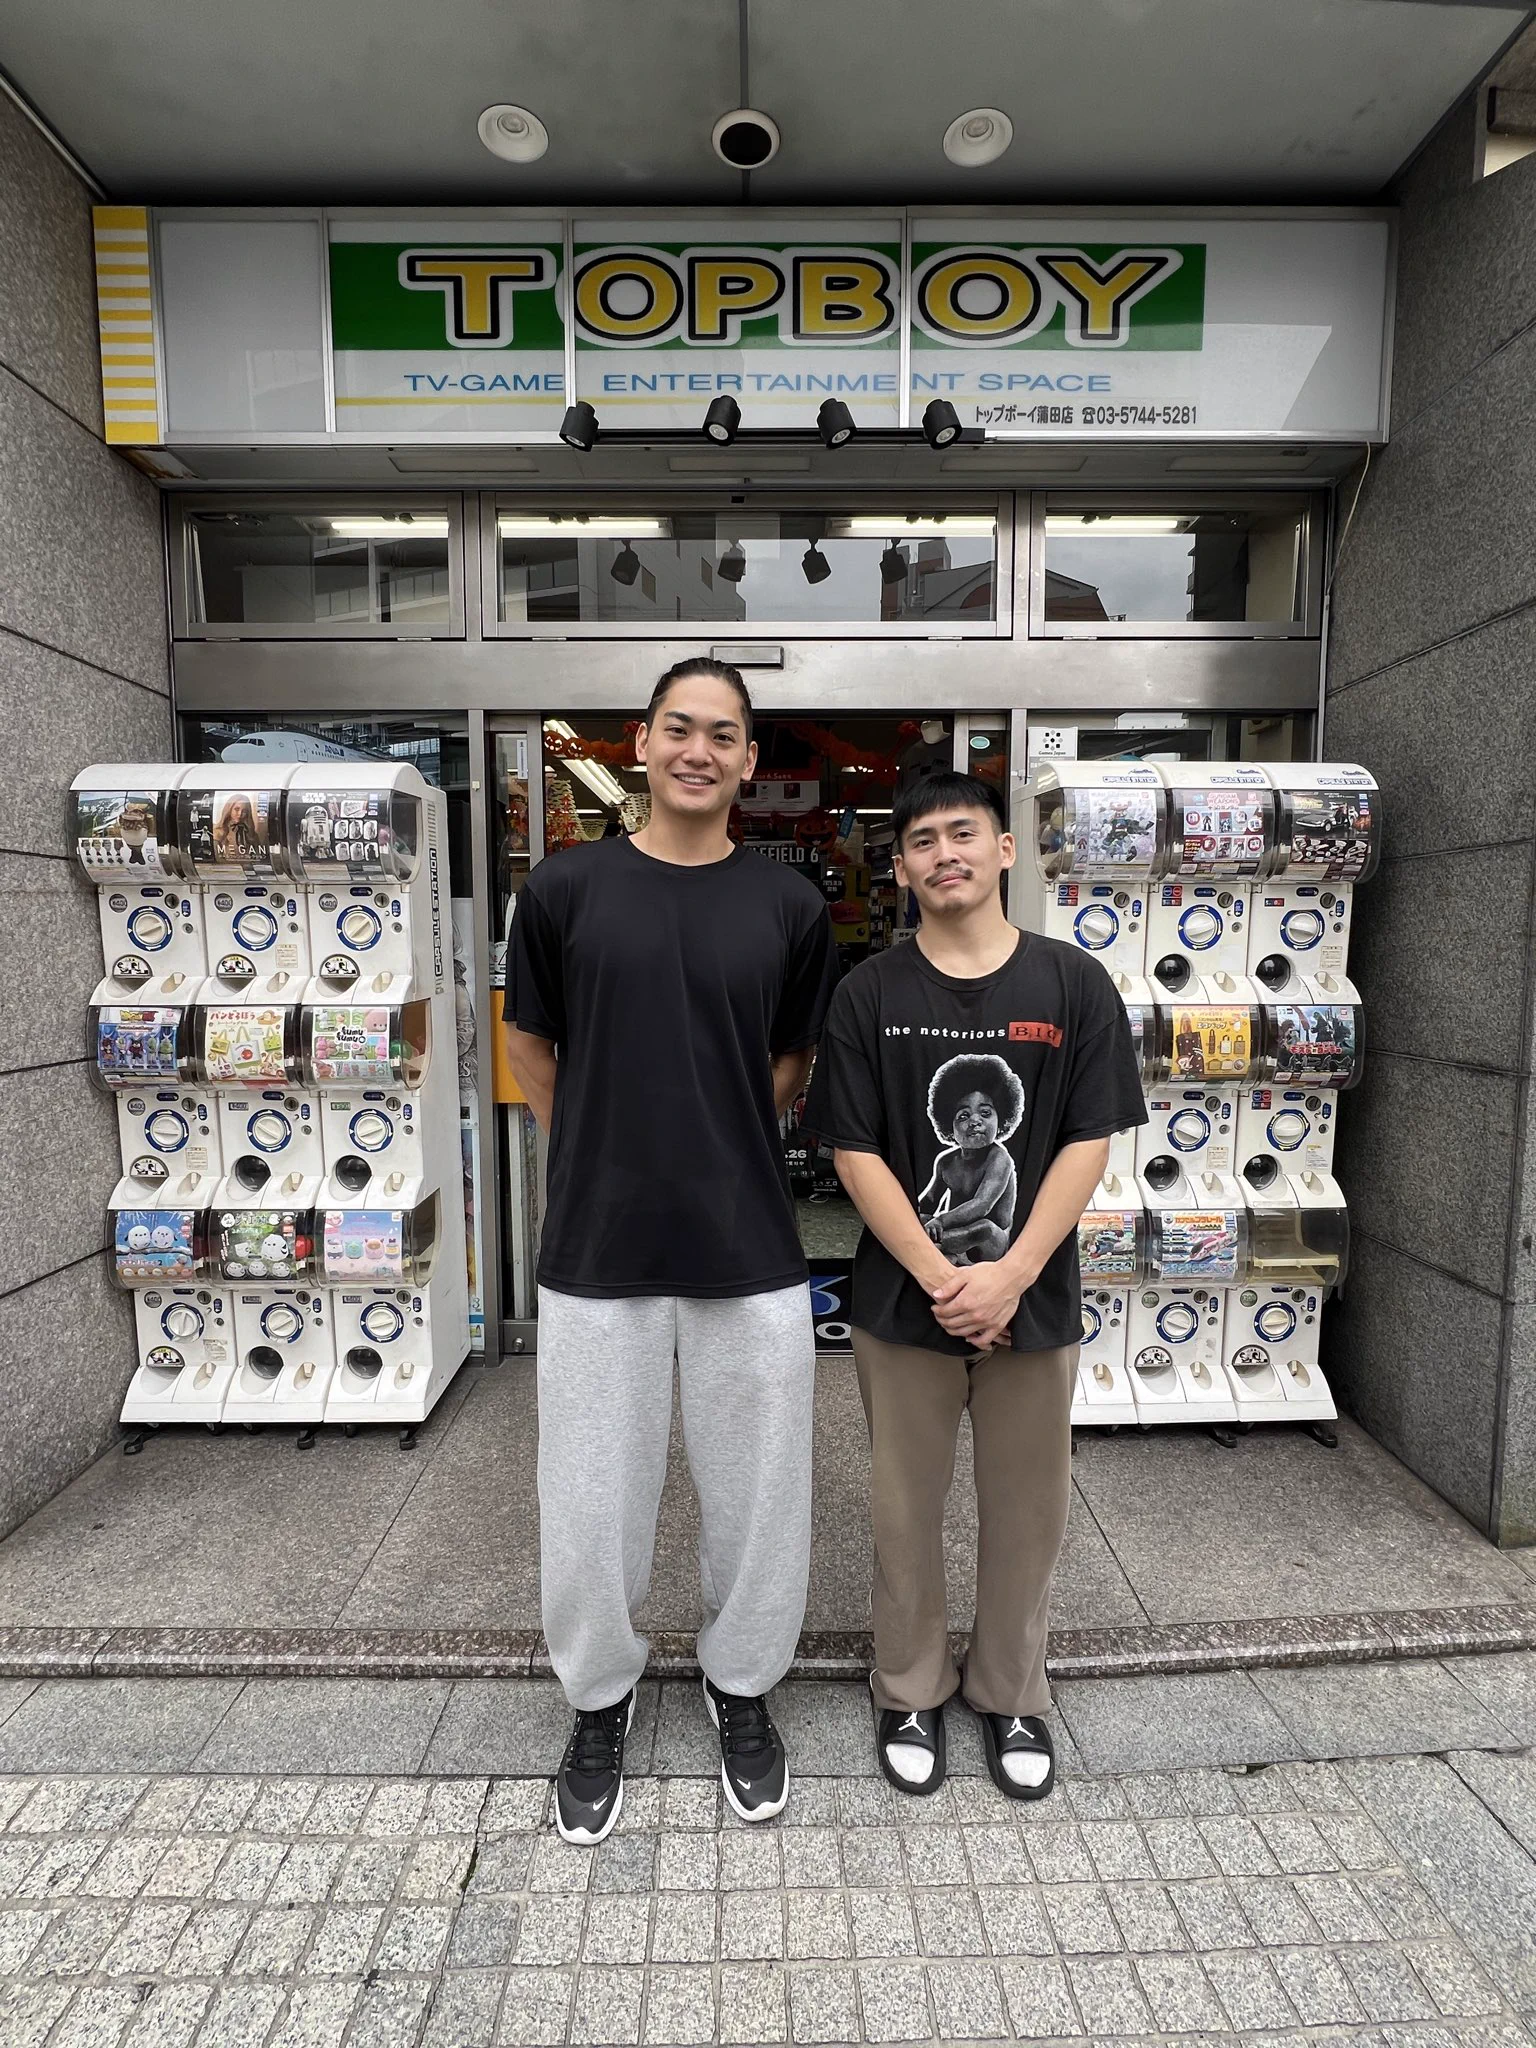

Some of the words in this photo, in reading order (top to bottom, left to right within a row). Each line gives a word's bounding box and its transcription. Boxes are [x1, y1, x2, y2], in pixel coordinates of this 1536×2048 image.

[404, 251, 1171, 342] TOPBOY
[403, 373, 564, 392] TV-GAME
[602, 373, 957, 393] ENTERTAINMENT
[977, 373, 1112, 393] SPACE
[975, 405, 1074, 424] トップボーイ蒲田店
[1096, 405, 1198, 425] 03-5744-5281
[810, 847, 819, 863] 6
[429, 848, 439, 910] STATION
[432, 910, 443, 977] CAPSULE
[210, 1011, 256, 1020] パンどろぼう
[336, 1031, 358, 1041] fumu
[341, 1026, 364, 1035] fumu
[885, 1026, 911, 1037] the
[920, 1027, 1006, 1040] notorious
